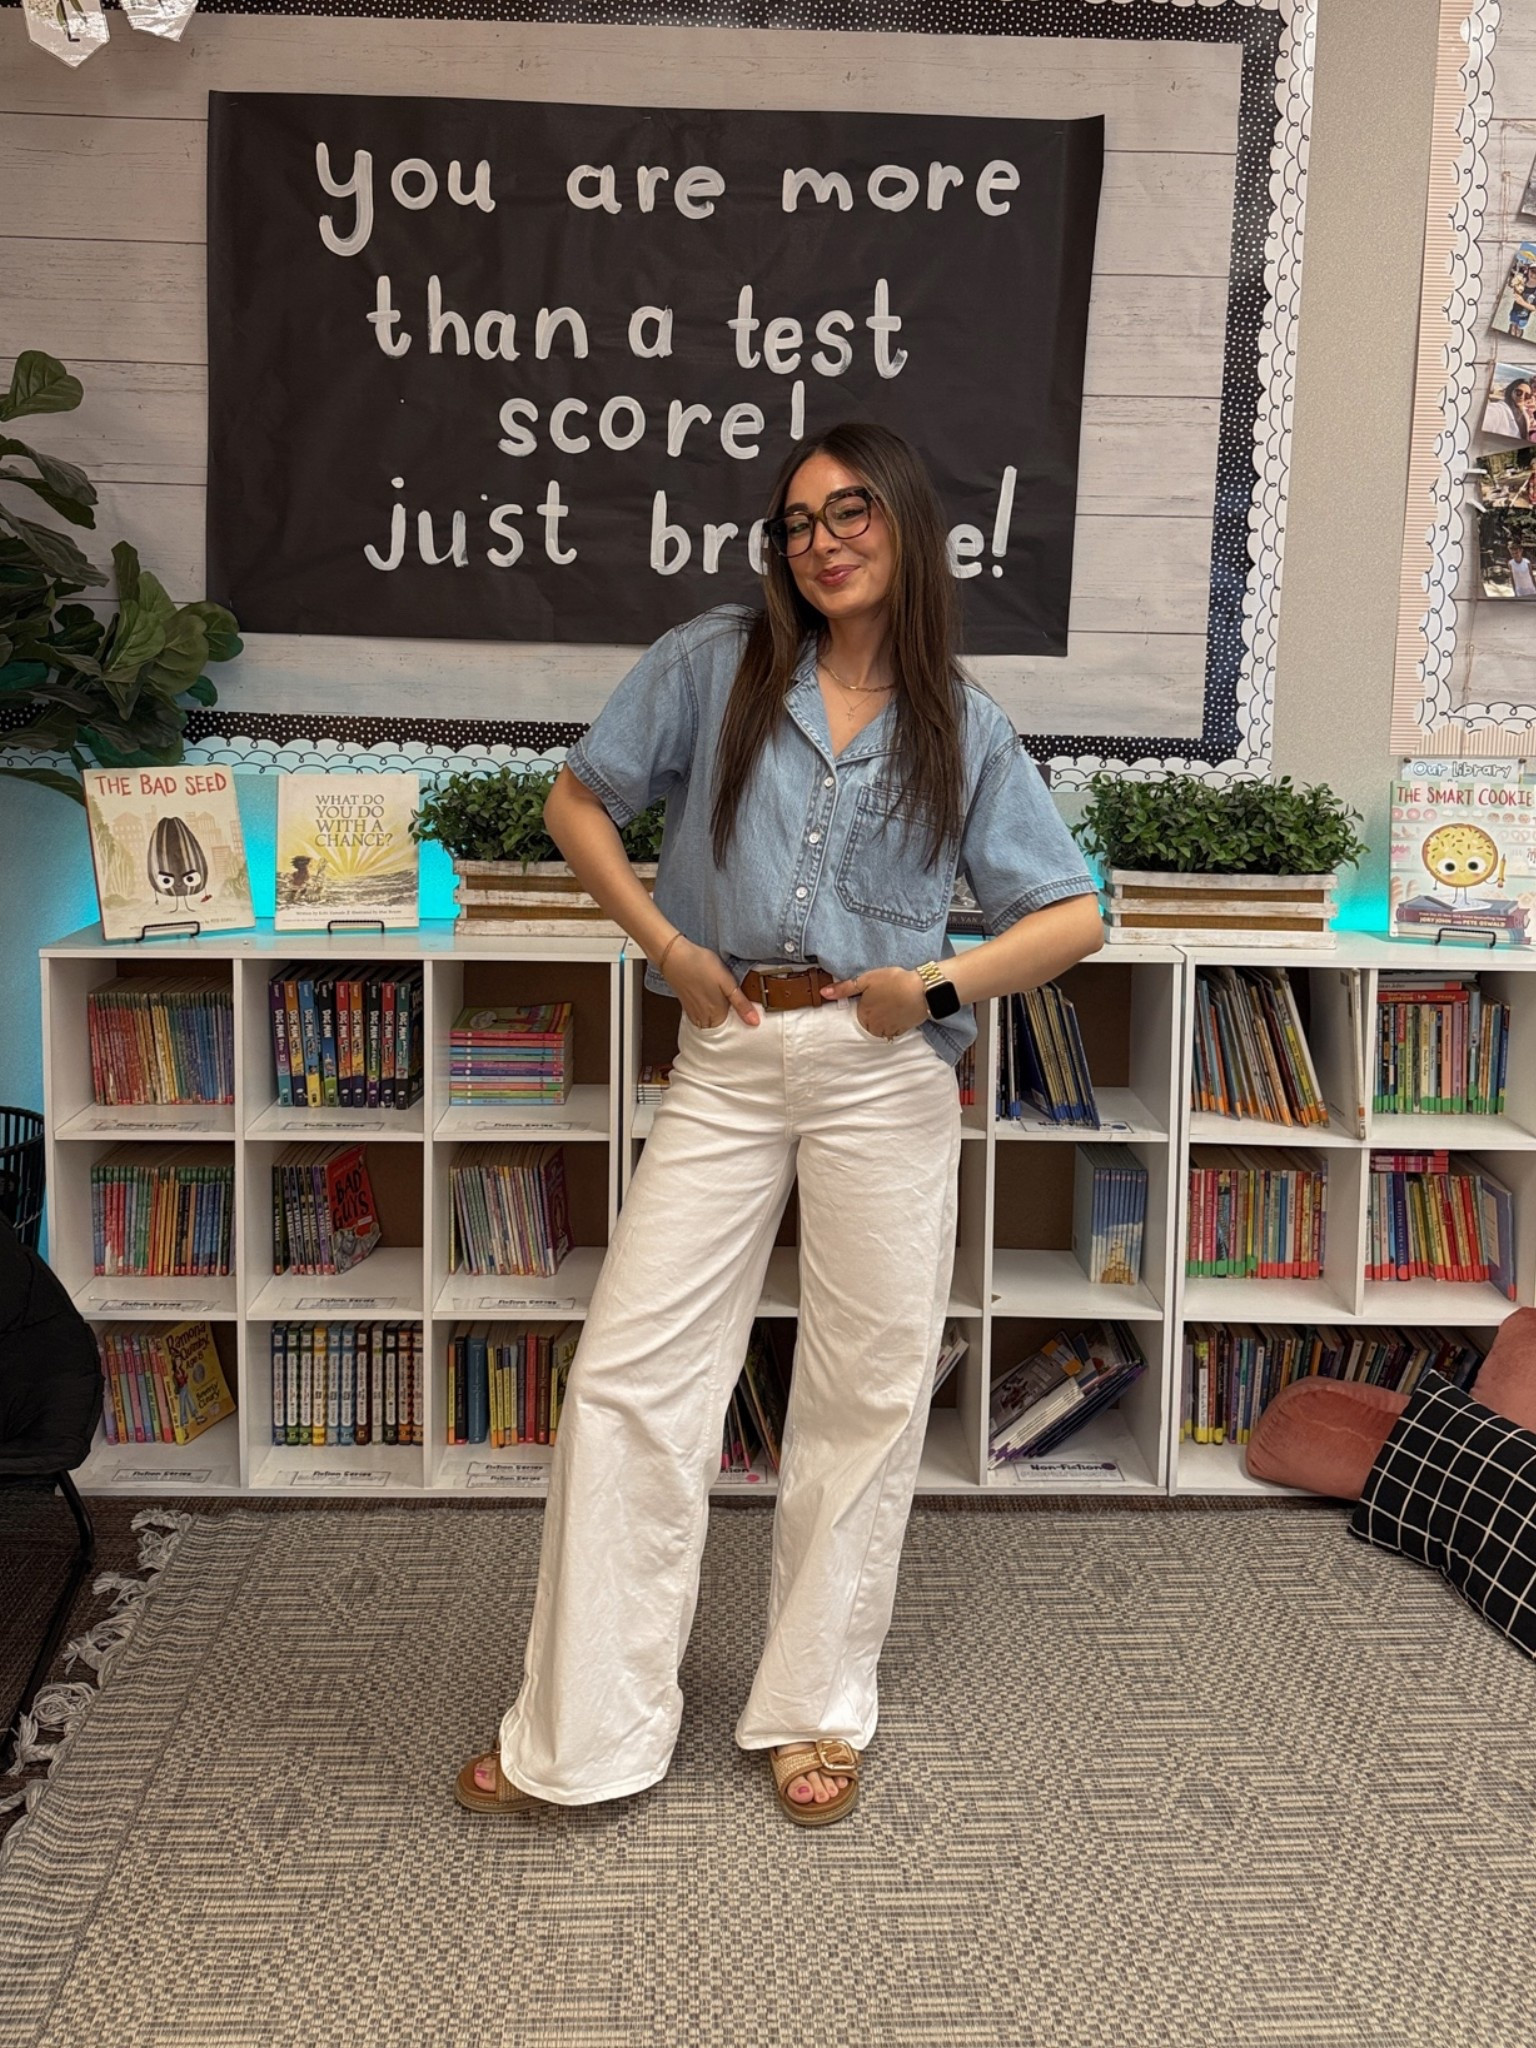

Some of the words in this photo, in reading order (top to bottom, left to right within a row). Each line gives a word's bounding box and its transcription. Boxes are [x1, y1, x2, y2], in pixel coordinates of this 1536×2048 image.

[317, 143, 496, 257] you
[566, 164, 725, 220] are
[782, 159, 1021, 217] more
[366, 274, 589, 362] than
[628, 305, 673, 358] a
[727, 278, 909, 379] test
[363, 477, 578, 572] just
[1413, 761, 1448, 777] Our
[1452, 761, 1512, 779] Library
[94, 775, 132, 796] THE
[140, 774, 177, 797] BAD
[185, 772, 227, 796] SEED
[1397, 786, 1421, 804] THE
[1427, 786, 1473, 806] SMART
[1478, 788, 1532, 807] COOKIE
[315, 794, 360, 805] WHAT
[362, 794, 385, 805] DO
[315, 805, 353, 819] YOU
[358, 805, 385, 819] DO
[315, 819, 367, 833] WITH
[371, 818, 384, 833] A
[315, 832, 394, 847] CHANCE?
[335, 1168, 362, 1206] BAD
[333, 1190, 370, 1233] GUYS
[166, 1320, 206, 1356] Ramona
